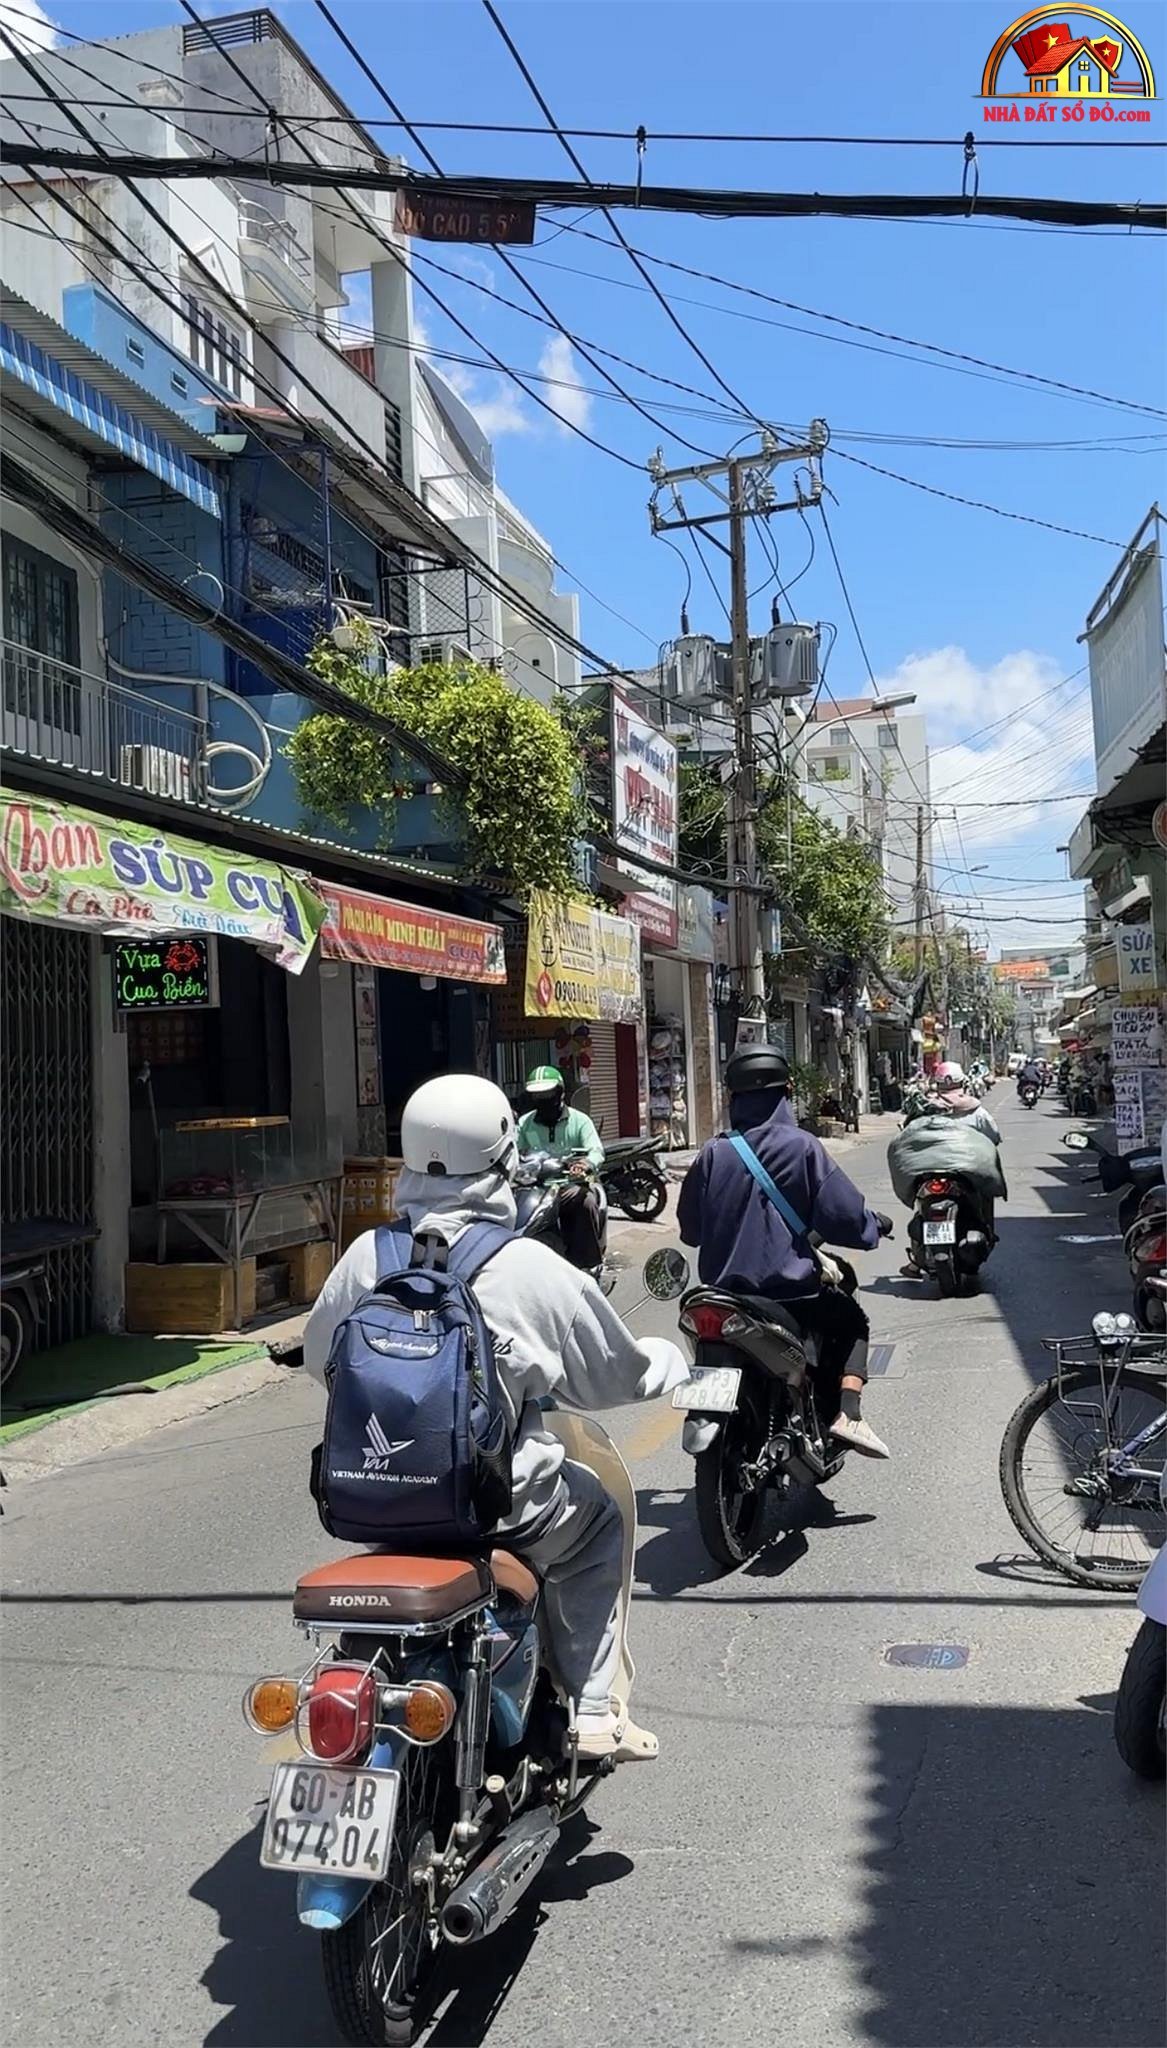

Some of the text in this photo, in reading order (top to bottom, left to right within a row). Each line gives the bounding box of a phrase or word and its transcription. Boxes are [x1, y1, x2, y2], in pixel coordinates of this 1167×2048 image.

[433, 213, 470, 236] CAO
[386, 918, 417, 945] MINH
[1121, 928, 1153, 952] SỬA
[122, 949, 162, 972] Vựa
[448, 943, 483, 963] CUA
[1129, 956, 1152, 975] XE
[122, 972, 205, 1001] Cua Biển
[332, 1470, 439, 1485] VIETNAM AVIATION ACADEMY
[328, 1595, 392, 1607] HONDA
[288, 1771, 377, 1821] 60-AB
[271, 1817, 381, 1871] 074.04
